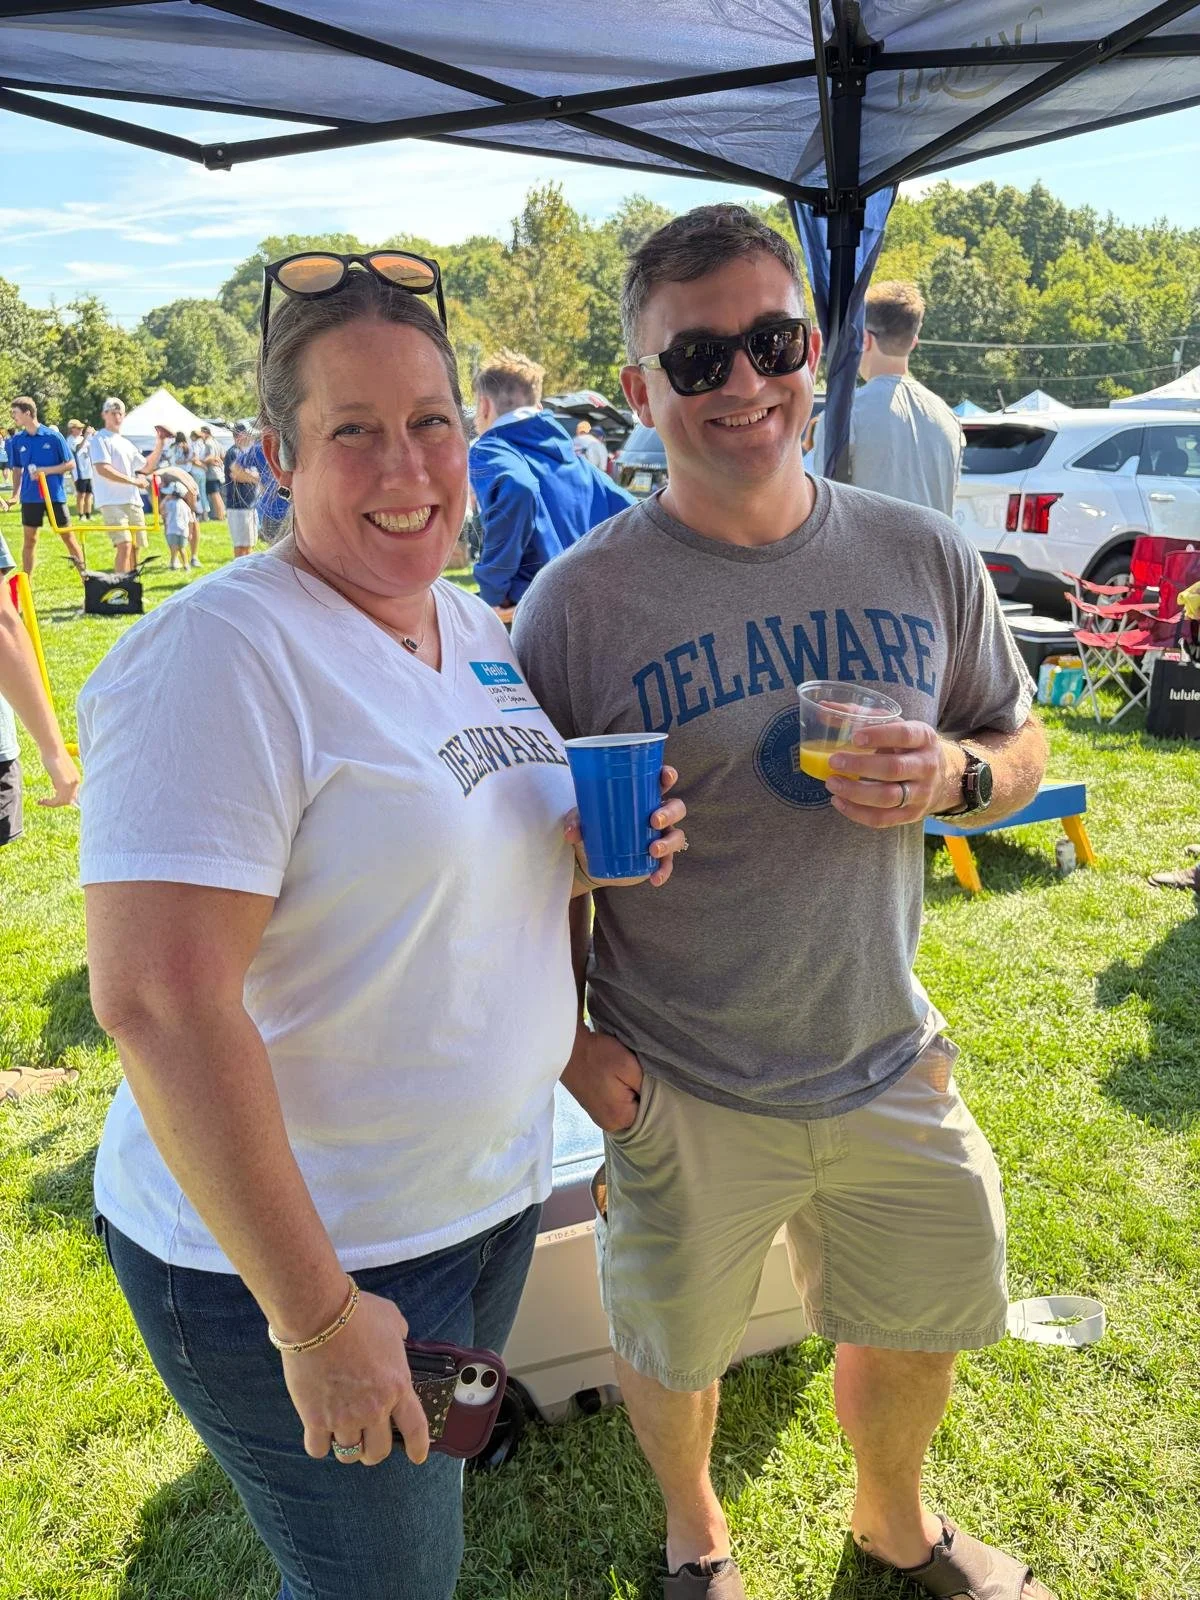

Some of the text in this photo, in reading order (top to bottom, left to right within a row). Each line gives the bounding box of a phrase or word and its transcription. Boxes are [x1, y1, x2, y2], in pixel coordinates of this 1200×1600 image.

[480, 663, 508, 676] Hello
[632, 608, 937, 733] DELAWARE
[1169, 687, 1200, 701] lulule
[438, 725, 570, 798] DELAWARE
